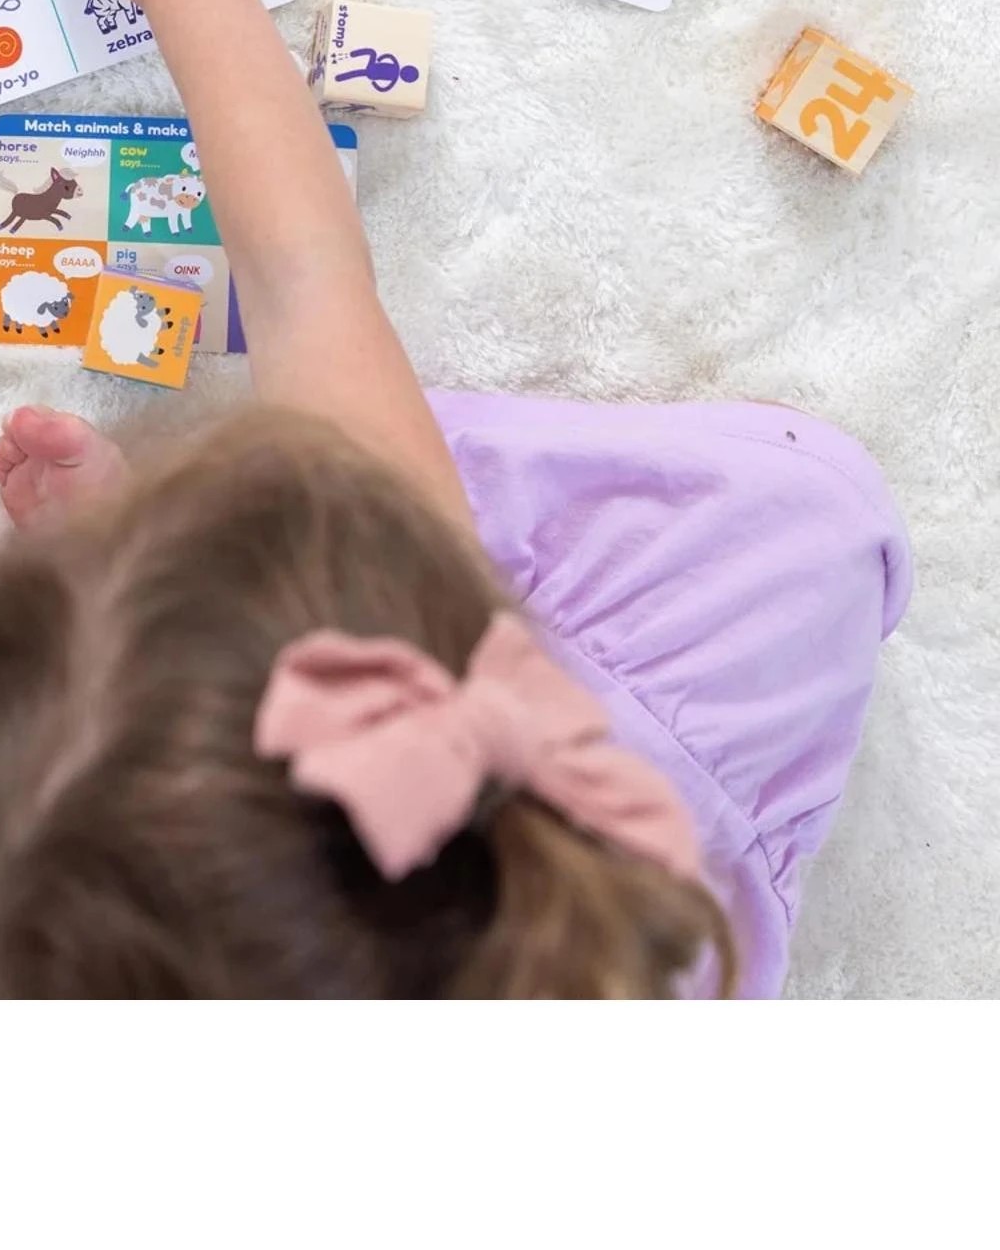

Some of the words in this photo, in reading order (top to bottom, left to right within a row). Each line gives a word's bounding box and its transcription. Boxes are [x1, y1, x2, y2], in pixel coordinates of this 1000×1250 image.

[332, 4, 349, 48] stomp
[106, 29, 153, 54] zebra
[799, 58, 896, 161] 24
[24, 119, 71, 133] Match
[75, 121, 129, 135] animals
[132, 123, 144, 136] &
[148, 123, 189, 137] make
[64, 147, 106, 159] Neighhh
[119, 146, 148, 156] cow
[116, 249, 137, 263] pig
[173, 265, 201, 275] OINK
